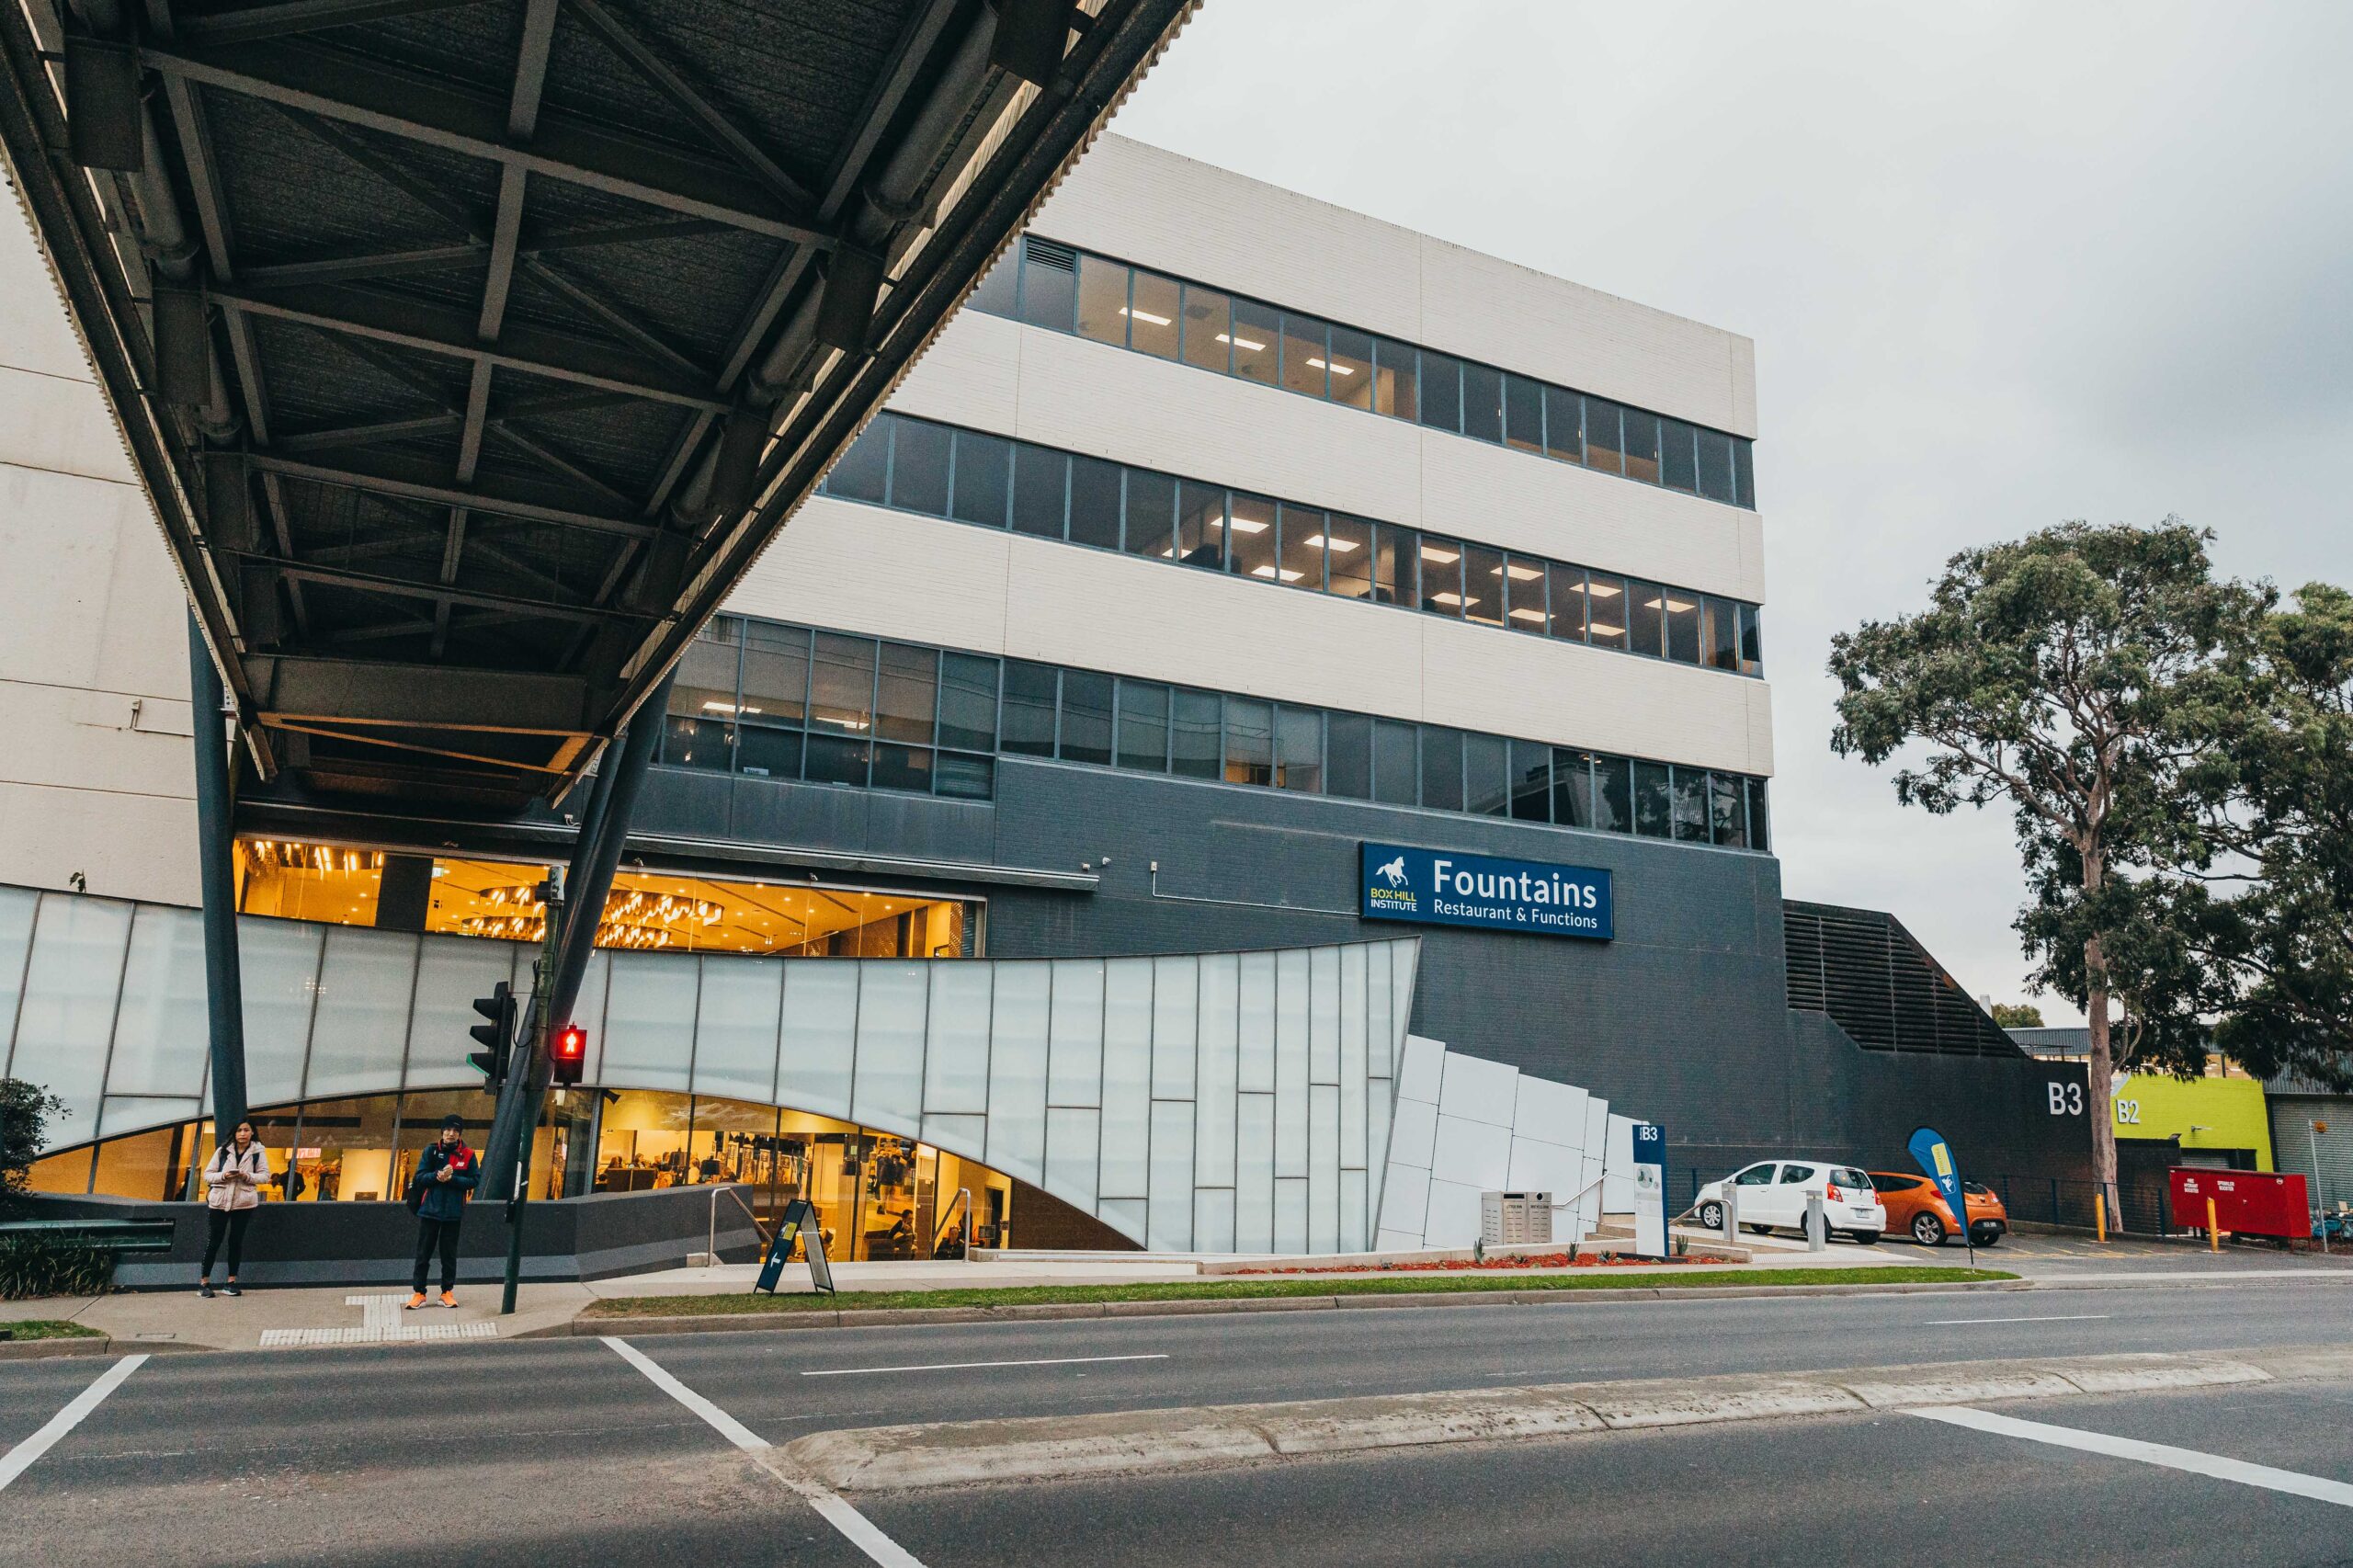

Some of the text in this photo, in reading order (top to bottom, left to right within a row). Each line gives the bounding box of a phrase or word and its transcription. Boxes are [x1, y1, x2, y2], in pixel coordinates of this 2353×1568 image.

[1370, 888, 1416, 902] BOX HILL
[1434, 859, 1597, 909] Fountains
[1370, 899, 1417, 912] INSTITUTE
[1434, 899, 1597, 928] Restaurant & Functions
[2048, 1082, 2083, 1116] B3
[2117, 1099, 2141, 1124] B2
[1643, 1126, 1658, 1141] B3
